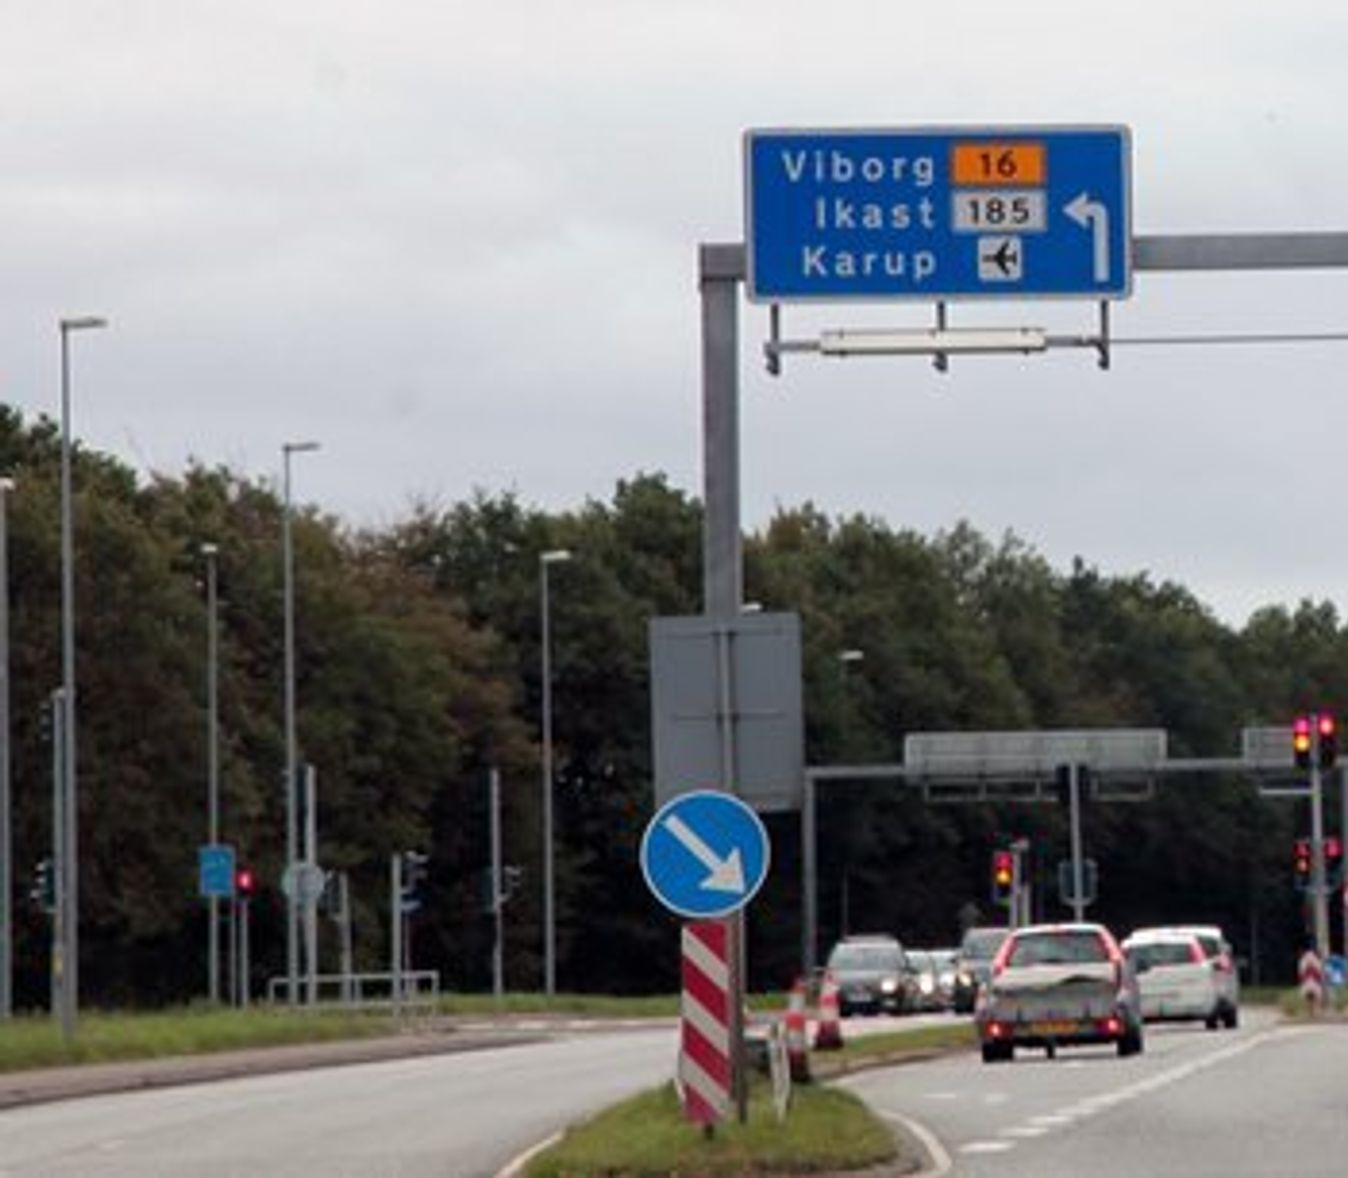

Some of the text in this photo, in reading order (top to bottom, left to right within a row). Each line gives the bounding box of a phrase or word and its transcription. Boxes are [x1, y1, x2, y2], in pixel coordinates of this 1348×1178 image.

[782, 150, 1019, 186] Viborg 16
[815, 195, 1031, 229] Ikast 185
[803, 245, 936, 282] Karup
